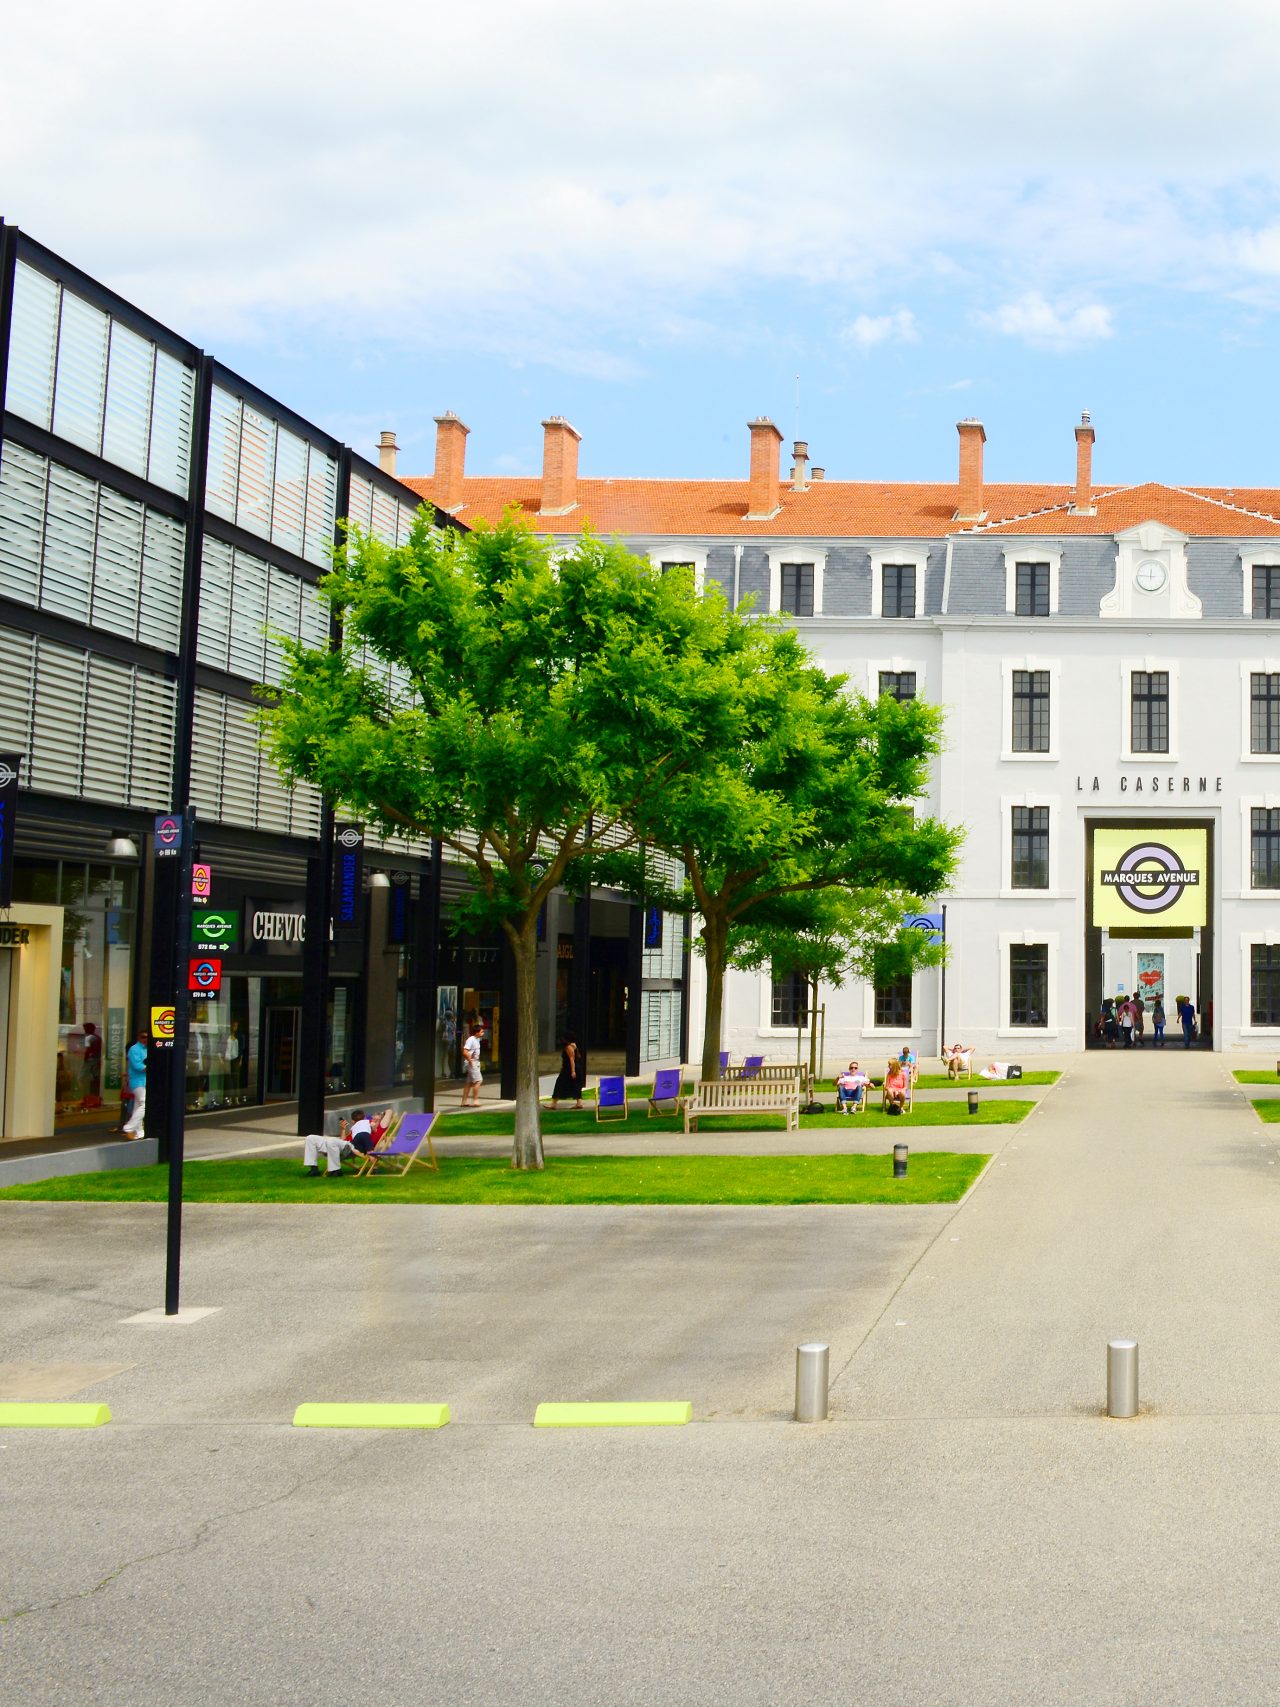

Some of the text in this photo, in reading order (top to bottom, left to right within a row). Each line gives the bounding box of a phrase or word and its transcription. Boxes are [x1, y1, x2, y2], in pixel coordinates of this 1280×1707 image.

[1077, 776, 1223, 792] LA CASERNE
[1103, 873, 1197, 884] MARQUES AVENUE
[340, 853, 357, 921] SALAMANDER
